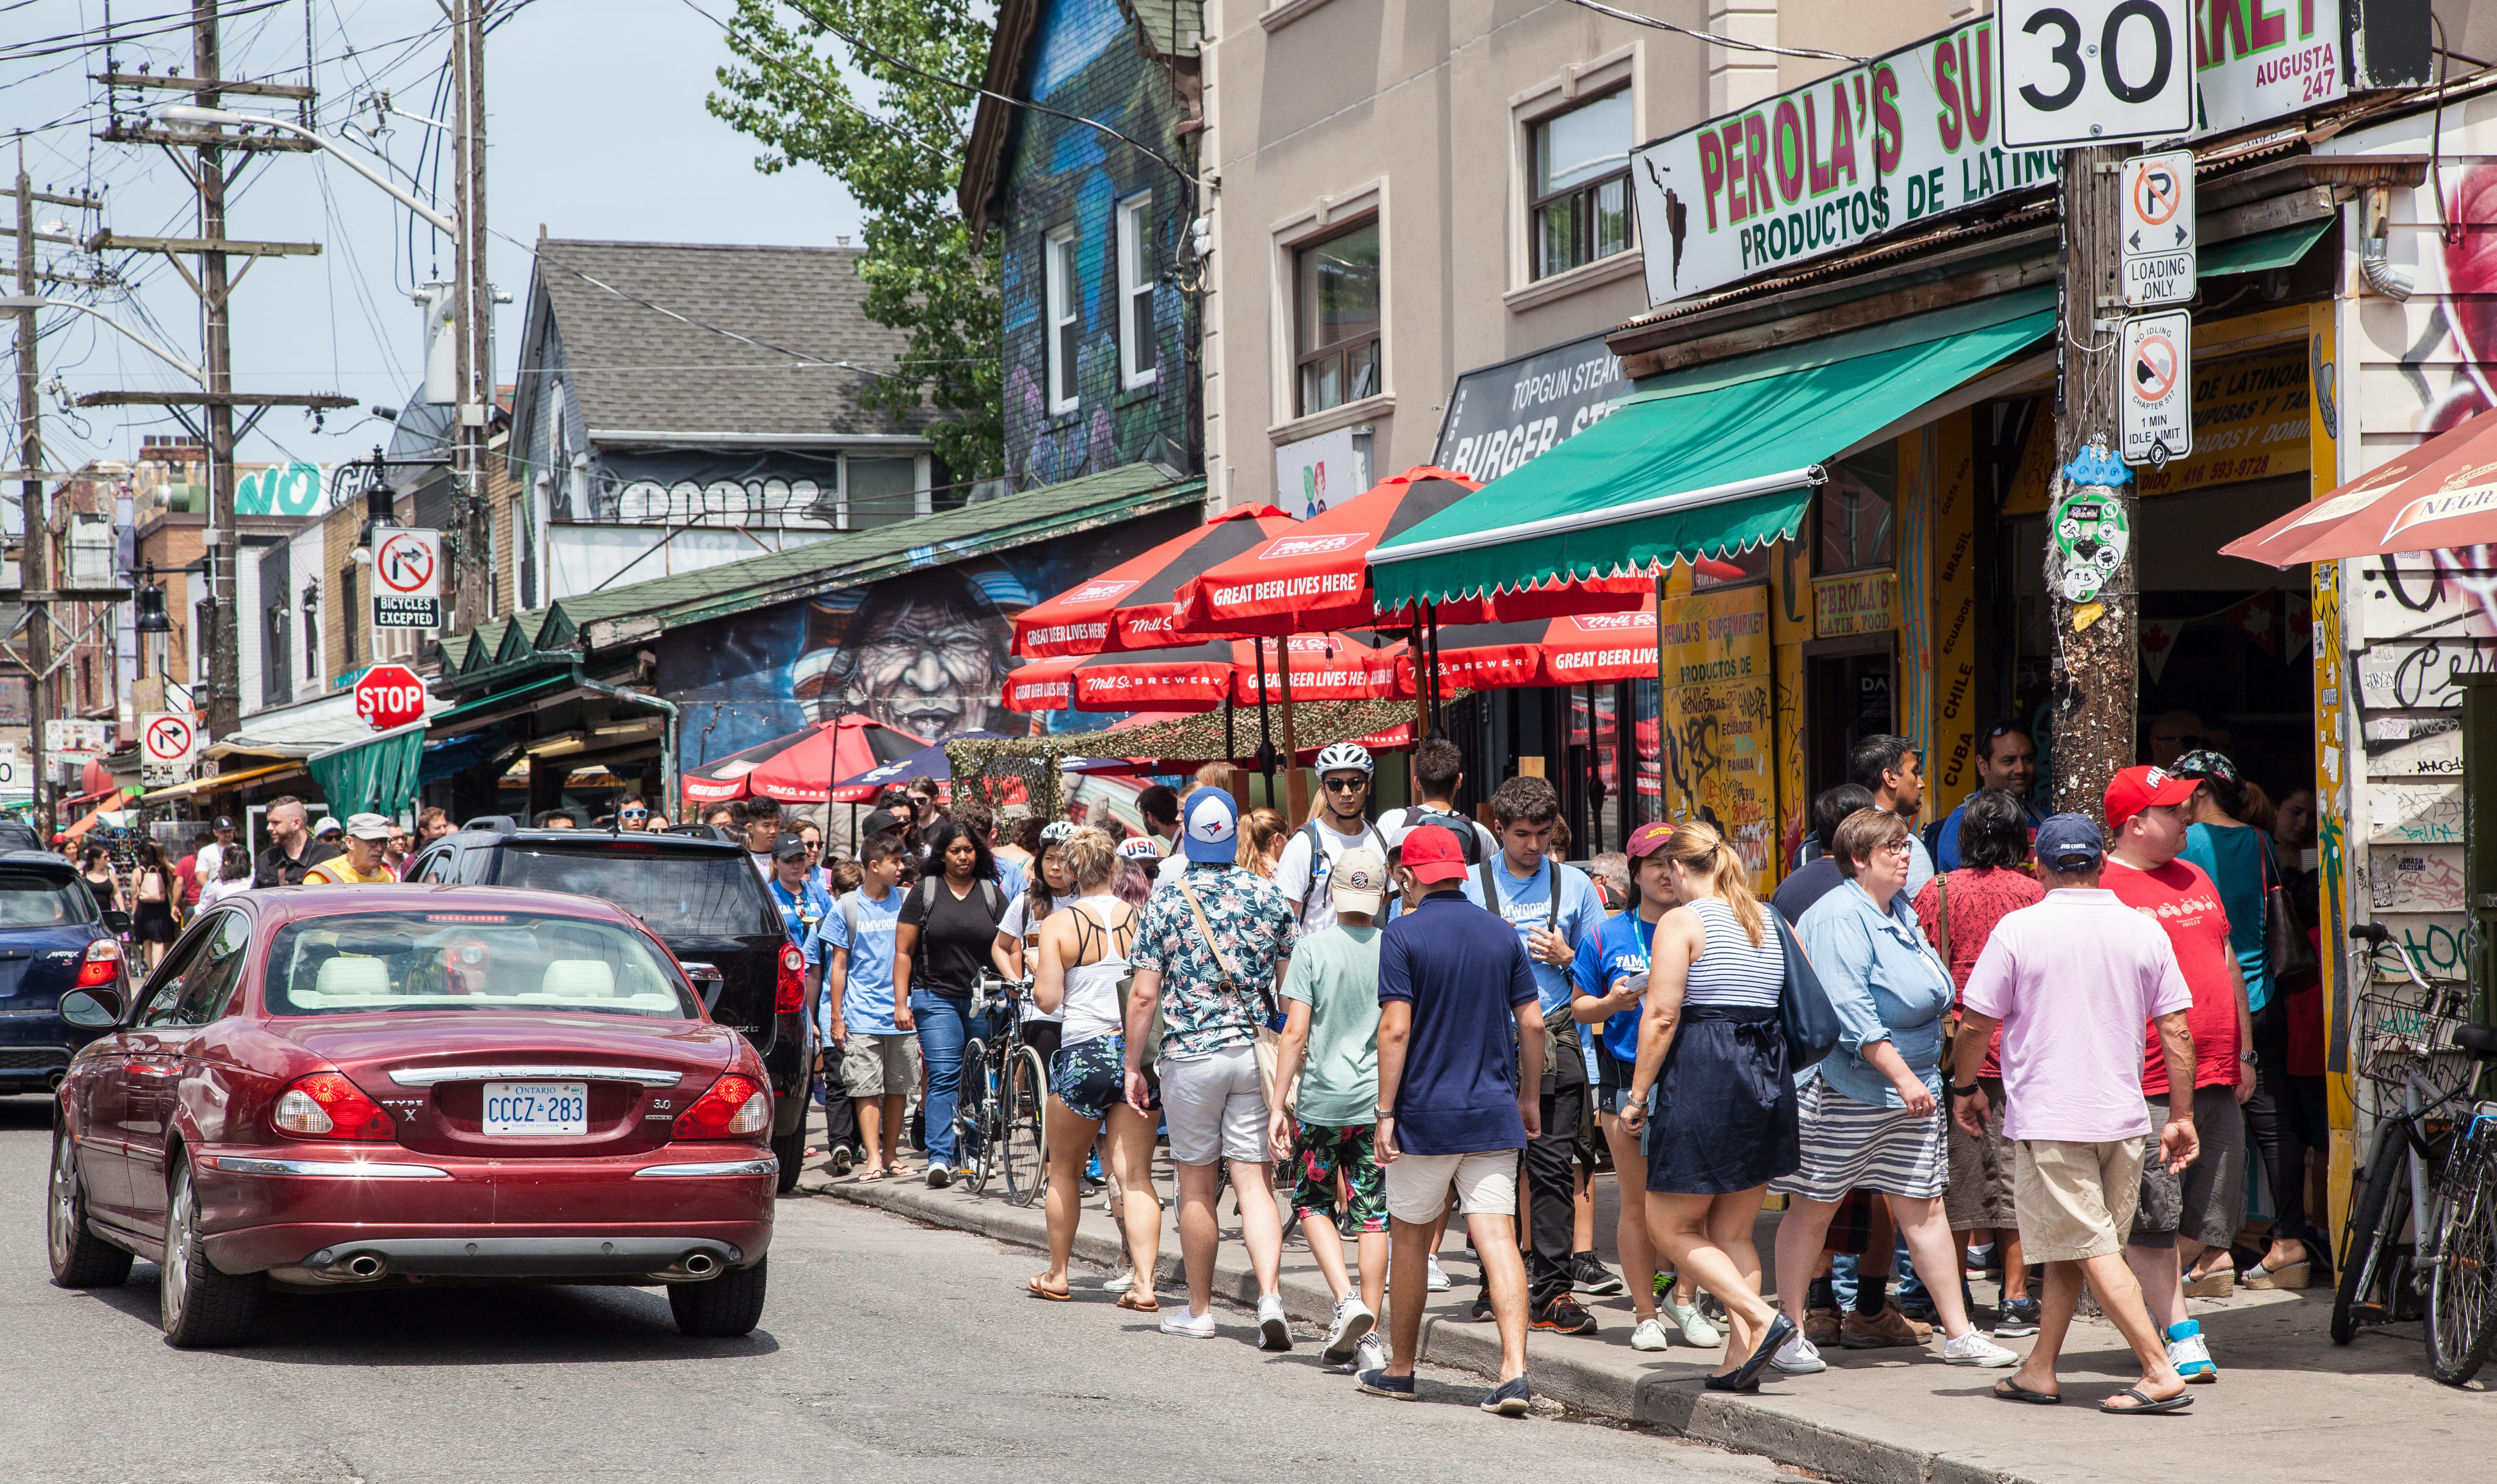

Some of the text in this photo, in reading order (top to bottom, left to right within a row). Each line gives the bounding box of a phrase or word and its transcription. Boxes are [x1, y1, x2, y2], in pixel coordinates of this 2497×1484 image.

[2019, 0, 2172, 112] 30
[2256, 42, 2334, 88] AUGUSTA
[2302, 68, 2335, 103] 247
[1697, 22, 1992, 234] PEROLA'S SU
[1740, 146, 2057, 270] PRODUCTOS DE LATIN
[2132, 257, 2186, 282] LOADING
[2134, 326, 2172, 346] NO IDLING
[1512, 355, 1622, 411] TOPGUN STEAK
[2194, 376, 2222, 403] DE
[2133, 390, 2176, 410] CHAPTER 517
[2262, 396, 2277, 416] Y
[1448, 389, 1468, 442] HAND
[2141, 415, 2167, 428] 1 MIN
[2129, 427, 2181, 445] IDLE LIMIT
[2243, 426, 2259, 446] Y
[1451, 415, 1559, 482] BURGER
[2182, 464, 2205, 485] 416
[2210, 454, 2270, 480] 593-9728
[1941, 456, 1972, 515] COSTA RICA
[1942, 529, 1973, 583] BRASIL
[1213, 584, 1254, 606] GREAT
[1255, 579, 1285, 601] BEER
[1286, 575, 1320, 597] LIVES
[1818, 578, 1890, 616] PEROLA'S
[380, 597, 431, 611] BICYCLES
[380, 612, 434, 625] EXCEPTED
[1128, 617, 1162, 634] Mill
[1820, 612, 1891, 636] LATIN FOOD
[1942, 597, 1973, 655] ECUADOR
[1027, 628, 1049, 647] GREAT
[1049, 626, 1066, 643] BEER
[1066, 623, 1089, 641] LIVES
[1664, 611, 1764, 647] PEROLA'S SUPERMARKET
[1452, 657, 1529, 672] BREWERY
[1555, 648, 1659, 670] GREAT BEER LIVE
[1248, 673, 1281, 689] GEAT
[1315, 671, 1347, 687] LIVES
[1680, 656, 1752, 684] PRODUCTOS DE
[1015, 684, 1030, 700] GREAT
[1030, 683, 1044, 698] BEER
[1043, 683, 1055, 698] LIVES
[1087, 675, 1221, 691] Mill St. BREWERY
[1861, 677, 1888, 692] DA
[1943, 662, 1974, 720] CHILE
[359, 686, 421, 714] STOP
[1682, 698, 1726, 715] HONDURAS
[1722, 720, 1752, 736] ECUADOR
[1727, 758, 1755, 773] PANAMA
[1944, 731, 1974, 788] CUBA
[766, 784, 787, 796] Mill
[1738, 787, 1755, 803] PERU
[1125, 840, 1156, 856] USA
[2398, 864, 2426, 872] RACISM!
[1500, 902, 1545, 917] MWOOD
[2182, 919, 2201, 928] JOULES
[46, 951, 80, 959] MATRIX
[454, 1069, 627, 1080] JAGUAR
[515, 1086, 556, 1095] ONTARIO
[489, 1097, 583, 1122] CCCZ 283
[653, 1099, 671, 1109] 3.0
[404, 1109, 417, 1122] X
